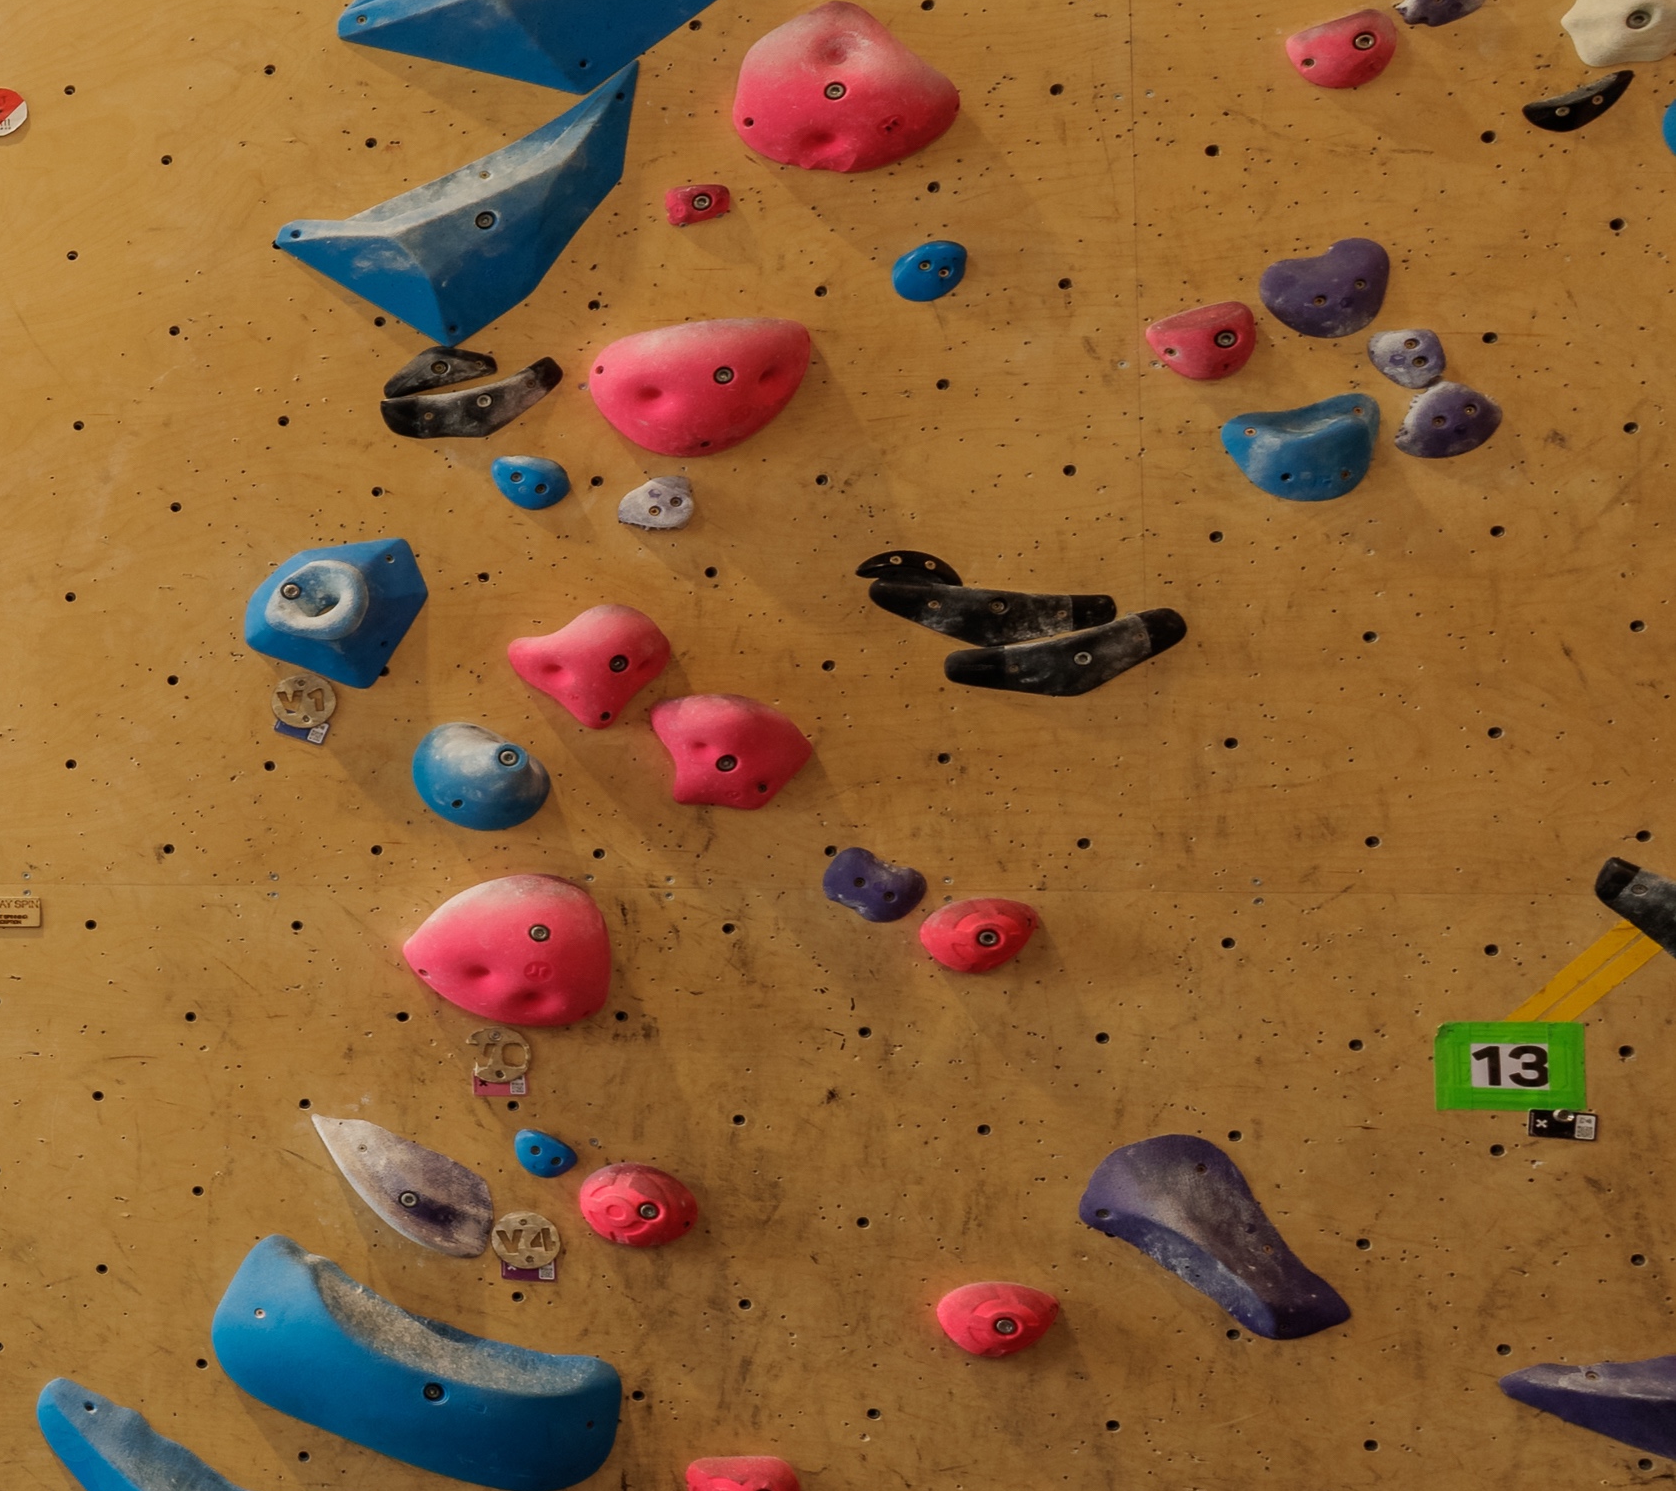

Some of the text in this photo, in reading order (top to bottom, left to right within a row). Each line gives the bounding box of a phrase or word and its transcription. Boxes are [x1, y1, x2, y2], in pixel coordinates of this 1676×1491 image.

[276, 688, 325, 712] V1
[14, 900, 39, 909] SPIN
[1471, 1045, 1549, 1088] 13
[495, 1227, 556, 1255] V4
